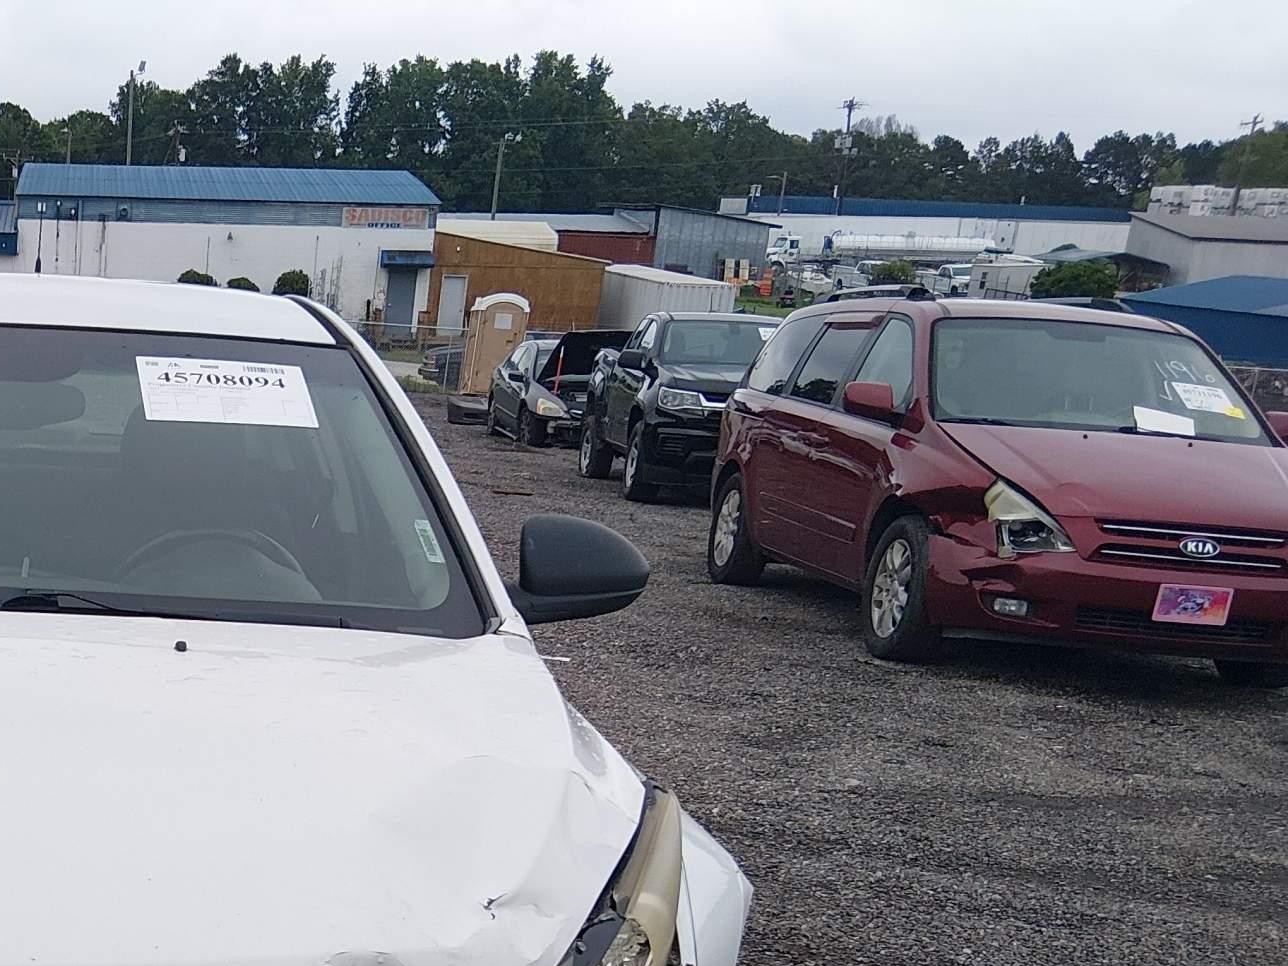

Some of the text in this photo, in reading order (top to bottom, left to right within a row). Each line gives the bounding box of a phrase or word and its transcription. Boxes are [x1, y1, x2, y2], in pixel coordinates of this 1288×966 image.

[346, 208, 427, 222] SADISCO
[157, 371, 286, 389] 45708094
[1187, 541, 1214, 554] KIA
